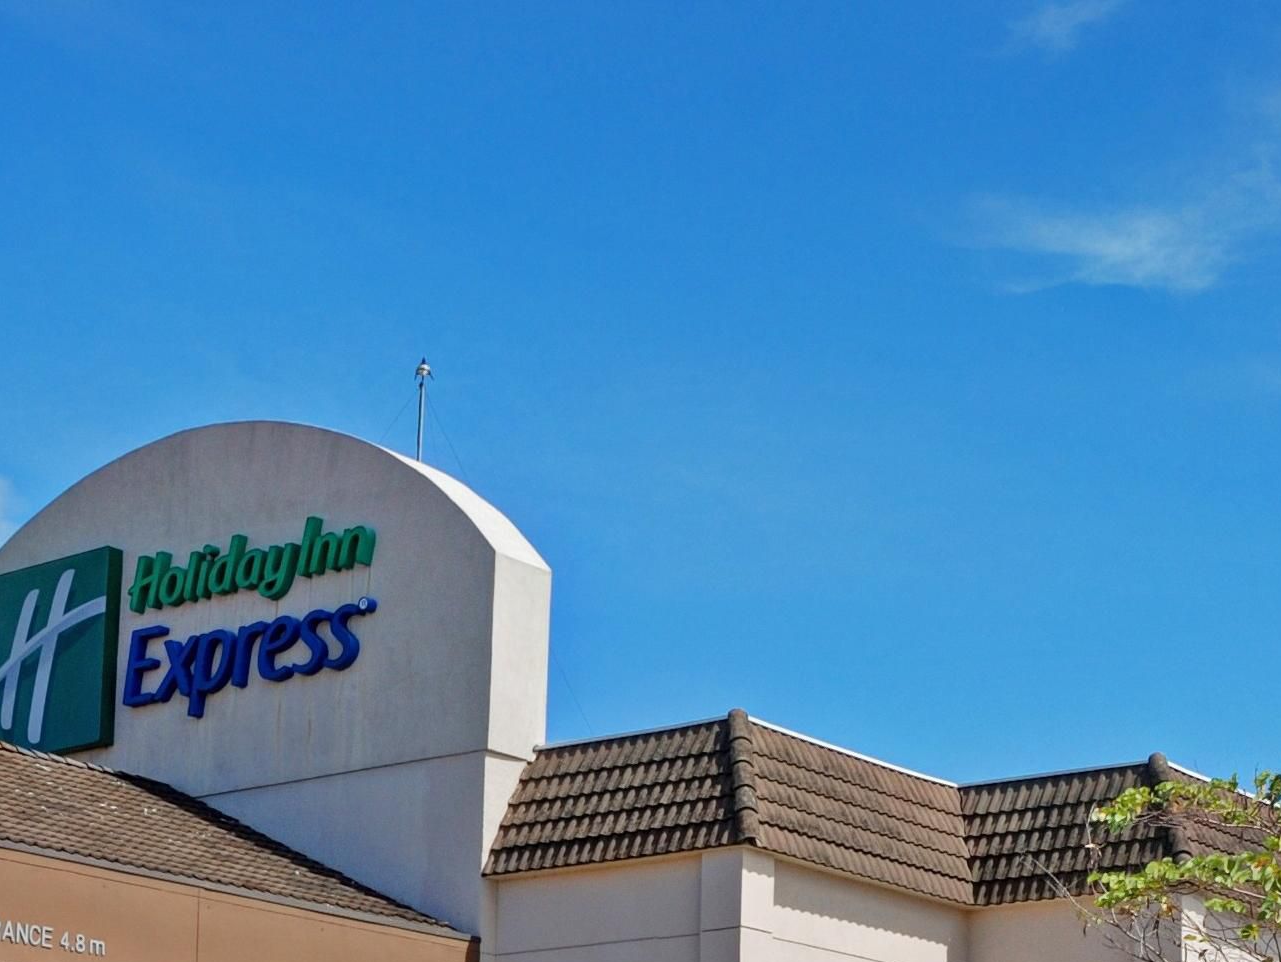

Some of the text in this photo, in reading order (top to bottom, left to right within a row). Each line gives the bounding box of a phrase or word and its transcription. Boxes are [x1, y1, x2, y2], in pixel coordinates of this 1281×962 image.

[122, 603, 370, 719] Express
[59, 930, 86, 953] 4.8
[88, 938, 107, 956] m
